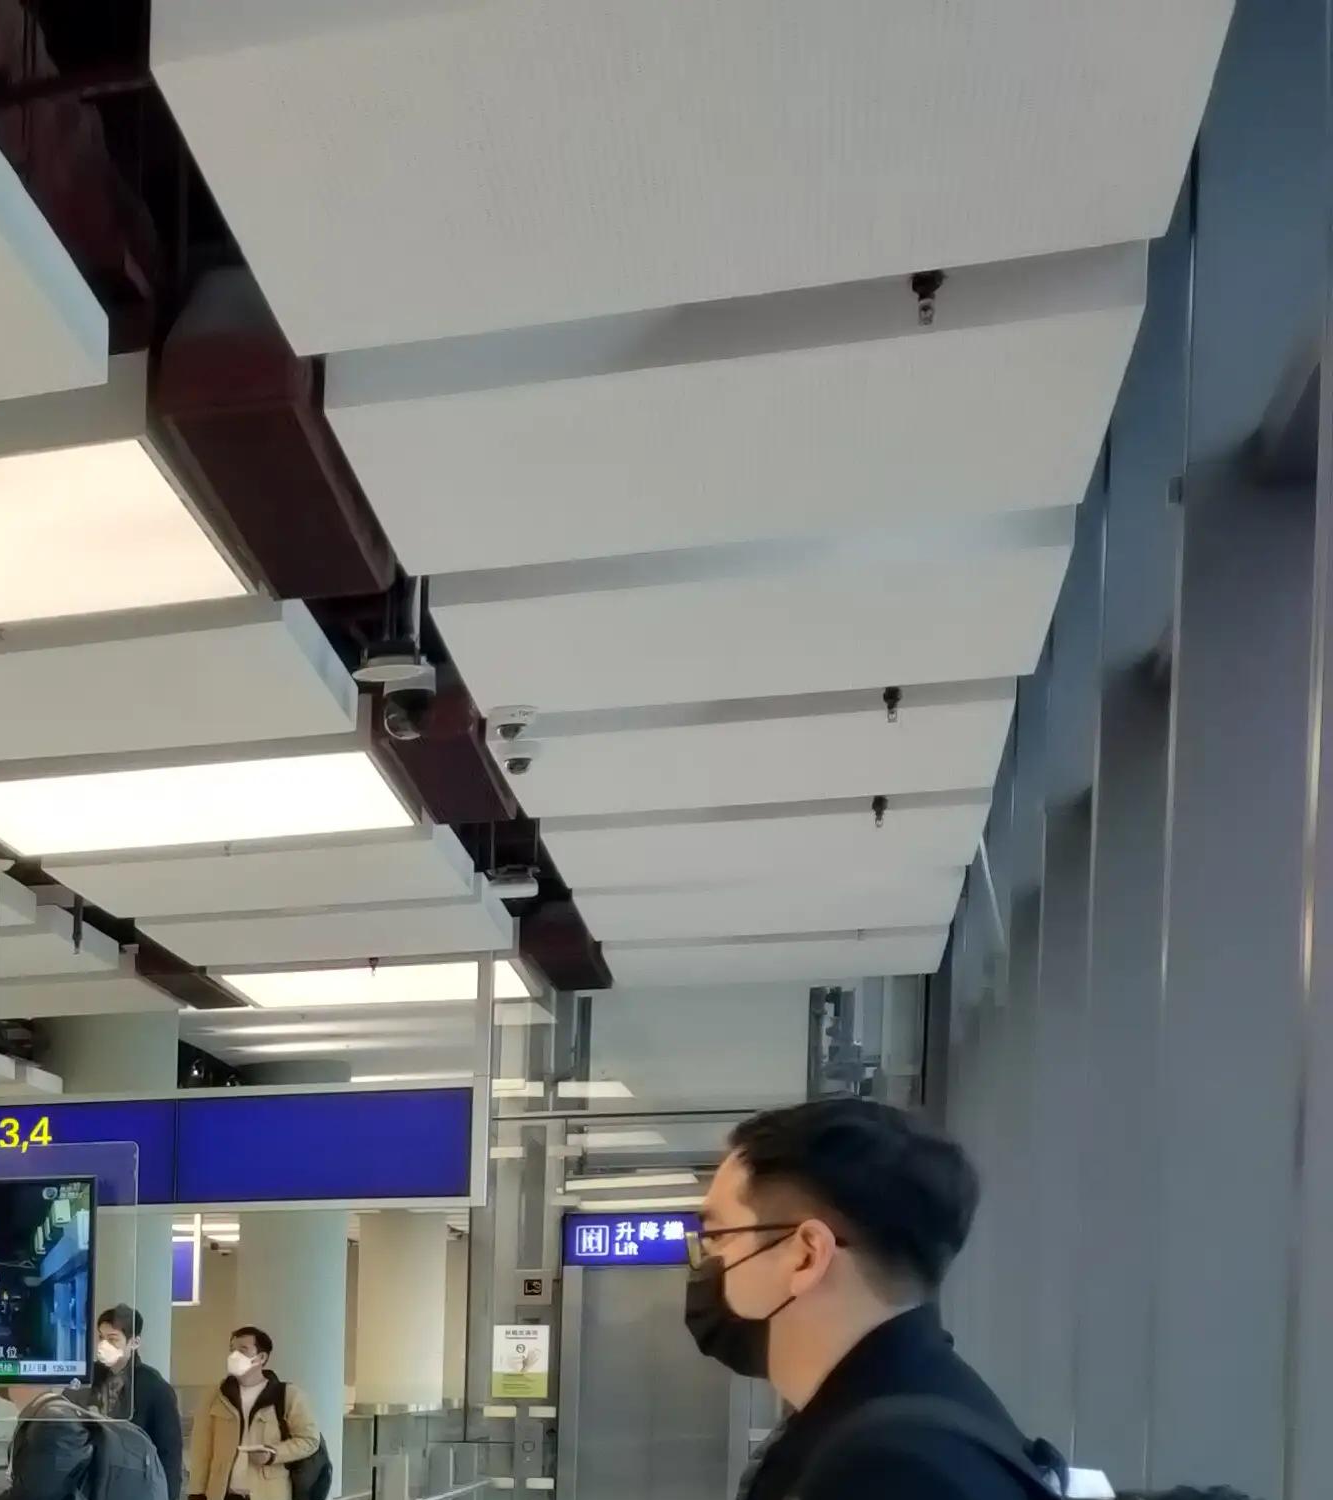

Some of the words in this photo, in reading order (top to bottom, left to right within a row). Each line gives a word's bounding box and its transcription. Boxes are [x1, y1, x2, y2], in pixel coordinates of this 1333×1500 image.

[614, 1221, 685, 1241] 升降機
[614, 1242, 639, 1256] Lift
